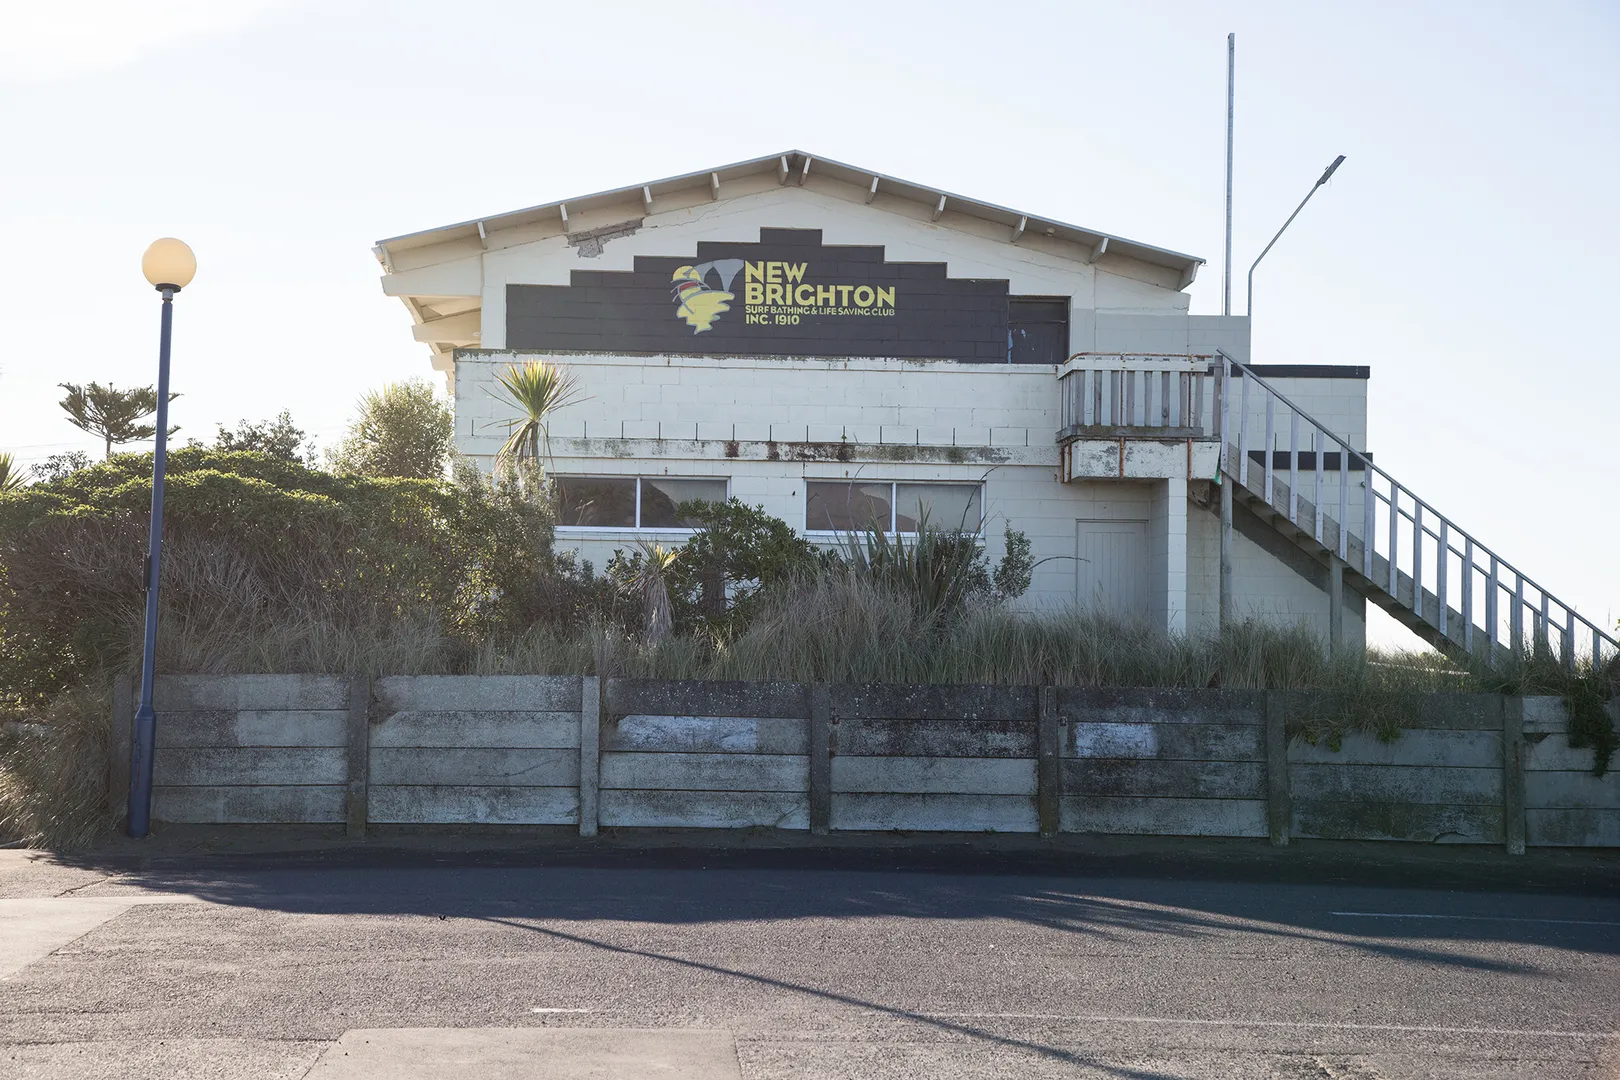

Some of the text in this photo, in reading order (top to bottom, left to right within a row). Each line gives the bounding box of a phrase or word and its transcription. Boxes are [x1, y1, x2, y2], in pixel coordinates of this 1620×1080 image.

[745, 260, 808, 283] NEW
[745, 283, 895, 307] BRIGHTON
[745, 305, 769, 314] SURF
[771, 305, 810, 315] BATHING
[819, 307, 837, 315] LIFE
[838, 307, 870, 316] SAVING
[872, 308, 895, 316] CLUB
[746, 314, 800, 325] INC. 1910
